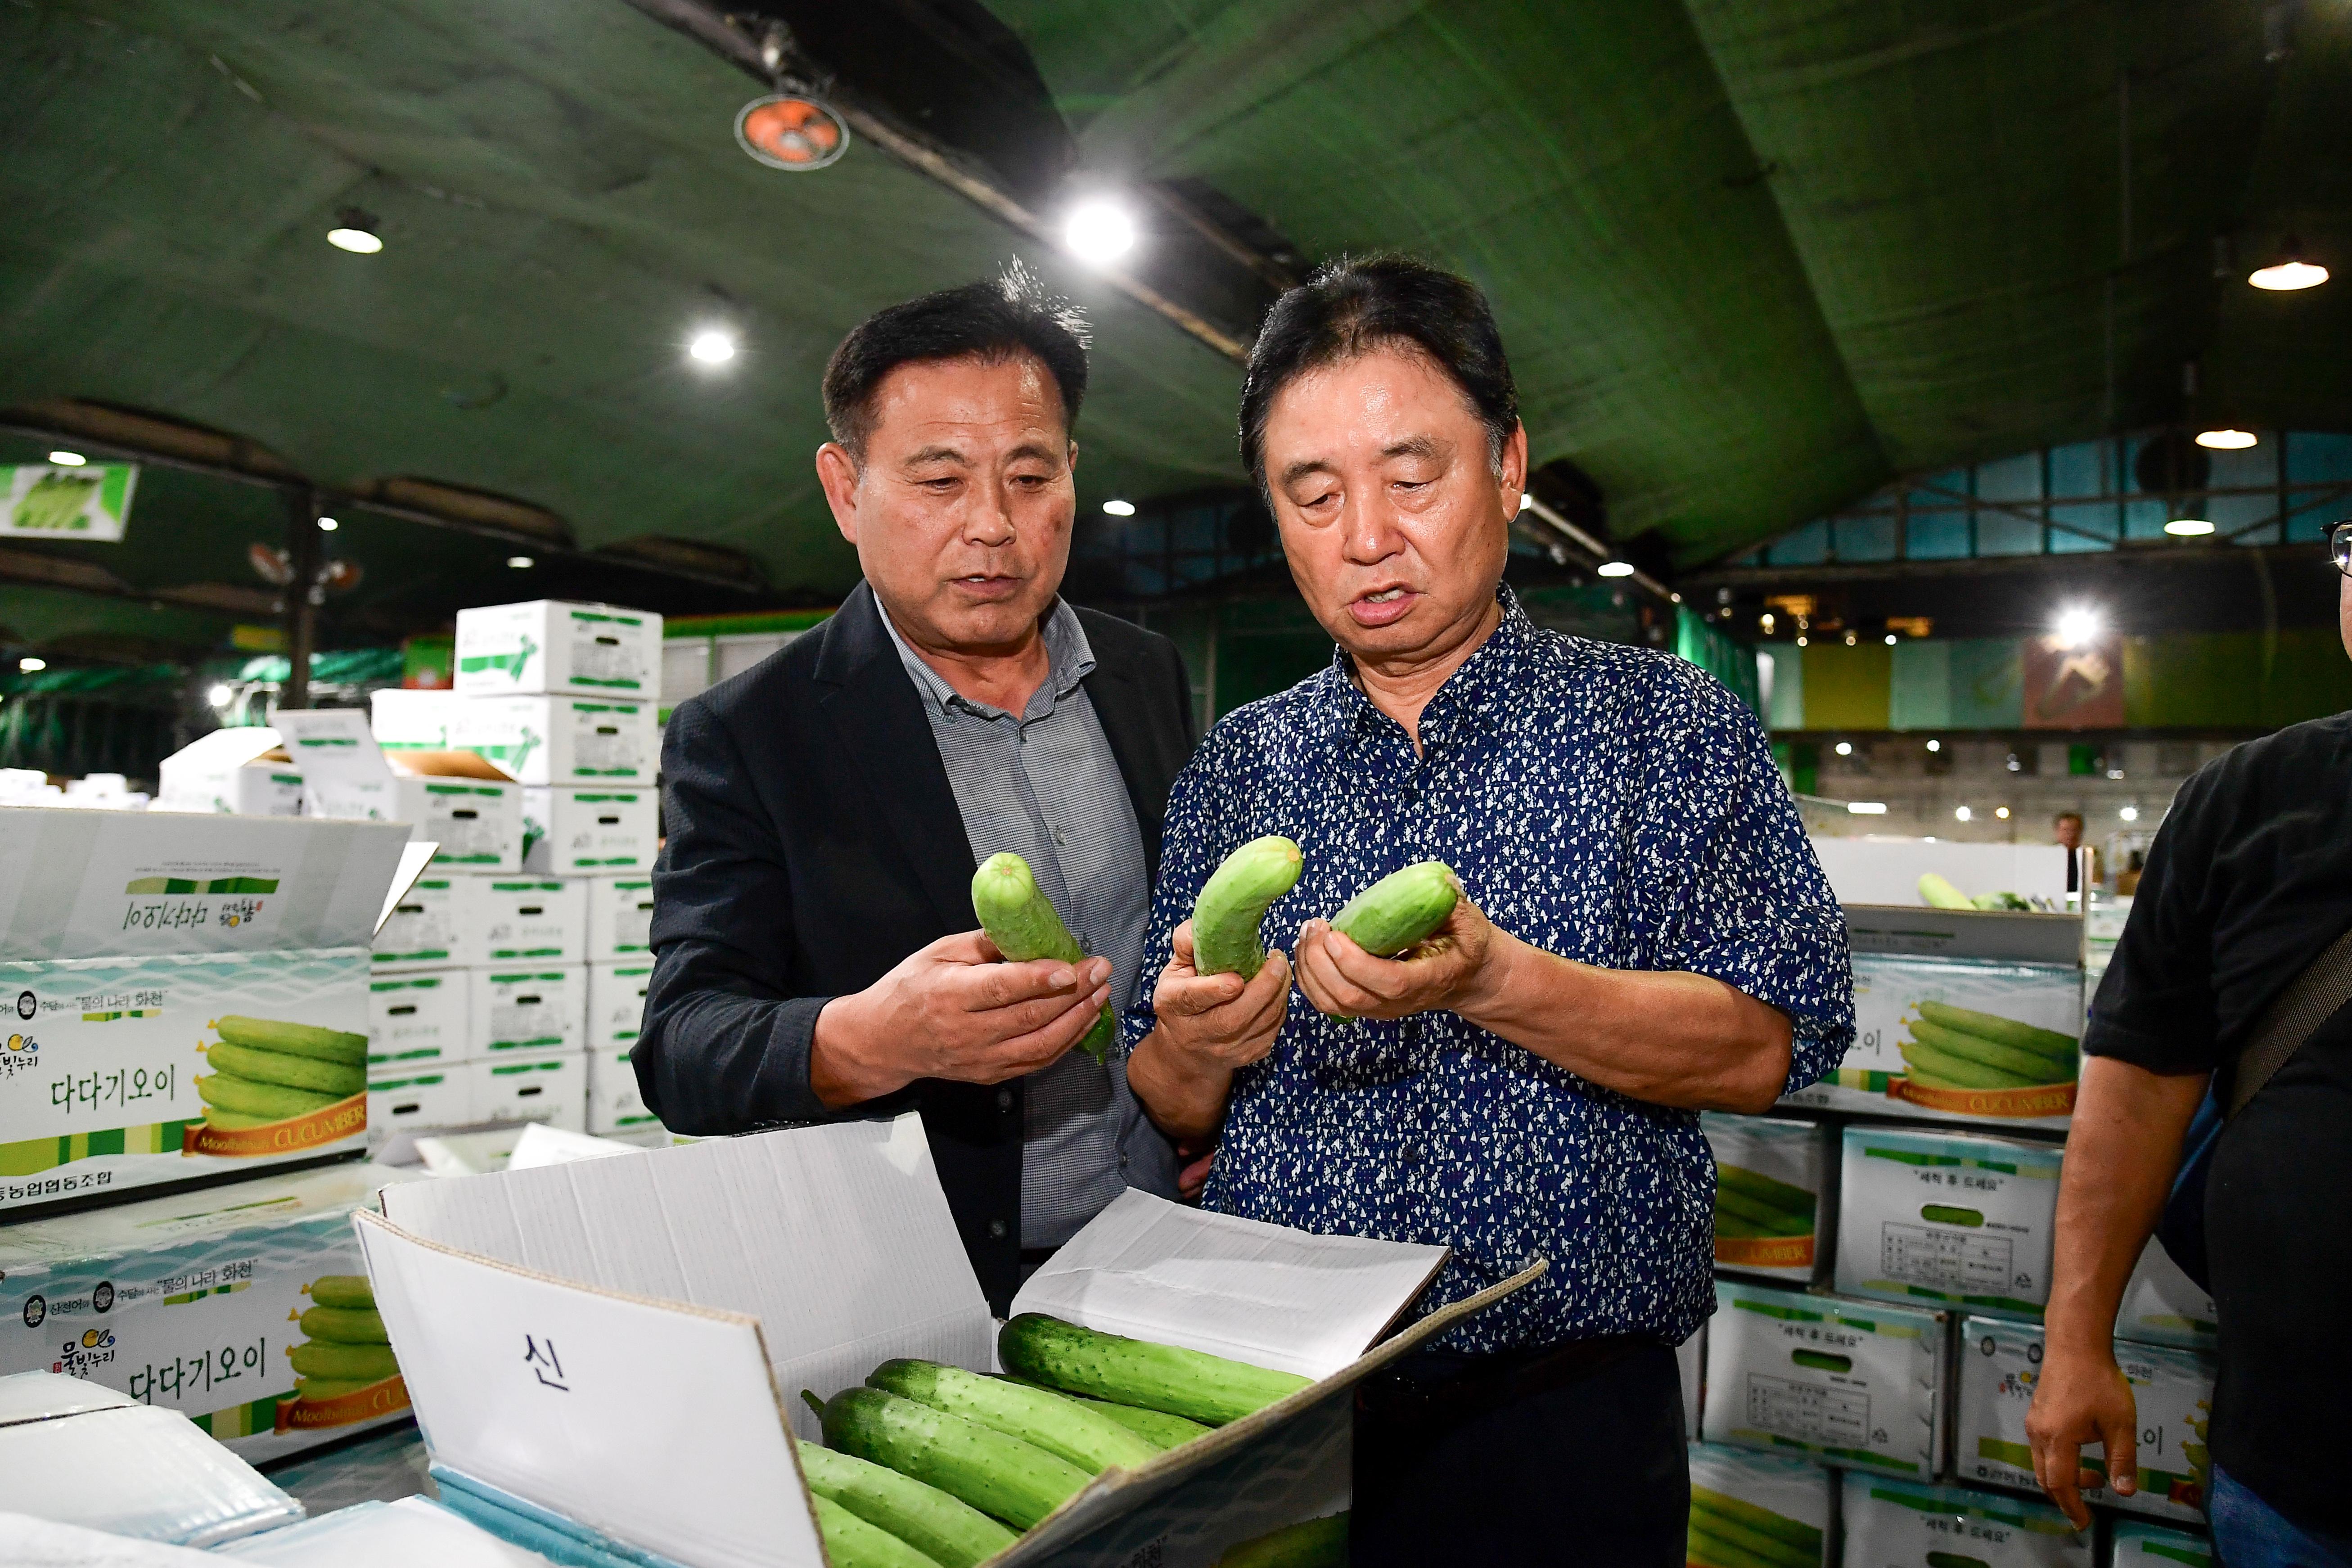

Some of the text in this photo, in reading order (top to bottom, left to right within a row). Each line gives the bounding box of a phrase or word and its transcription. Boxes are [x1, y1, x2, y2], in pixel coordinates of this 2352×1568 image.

[123, 901, 208, 929] 다다기오이
[108, 994, 129, 1008] 나라
[51, 1063, 175, 1114] 다다기오이
[274, 1104, 366, 1148] CUCUMBER
[192, 1270, 216, 1286] 나라
[61, 1341, 114, 1379] 물빛누리
[130, 1337, 266, 1405] 다다기오이
